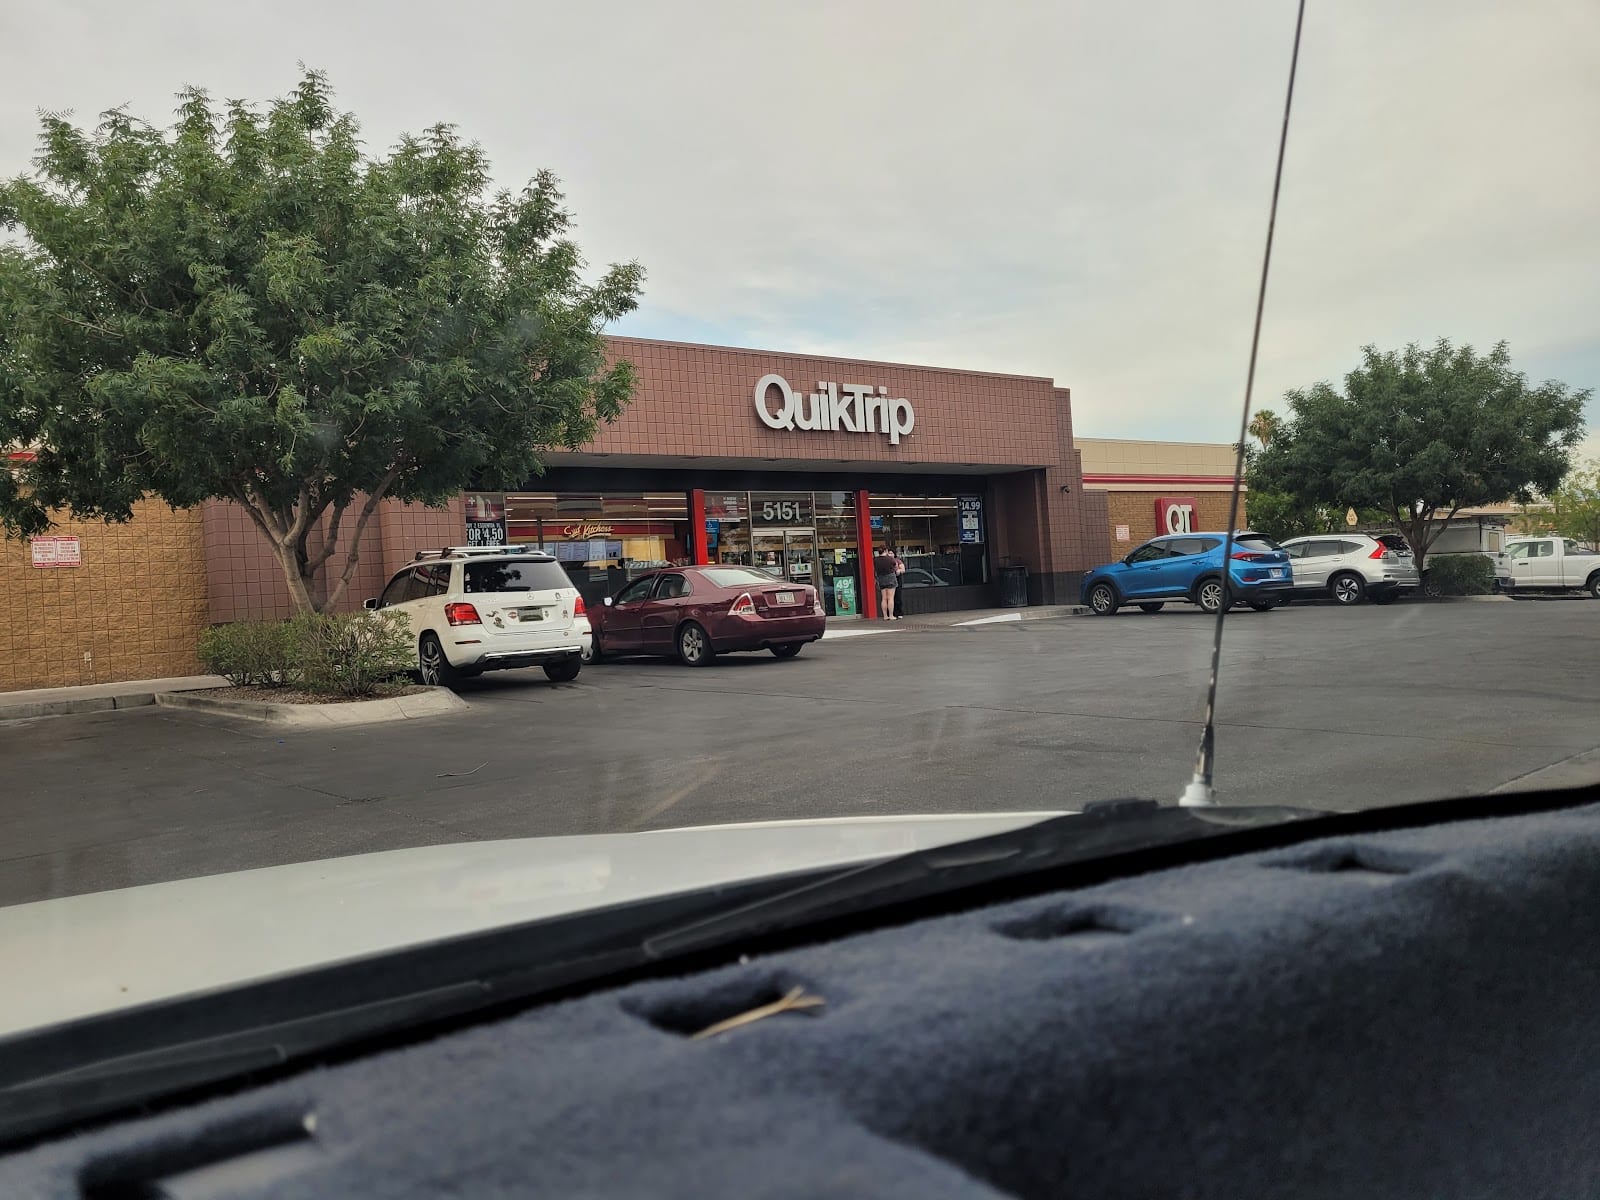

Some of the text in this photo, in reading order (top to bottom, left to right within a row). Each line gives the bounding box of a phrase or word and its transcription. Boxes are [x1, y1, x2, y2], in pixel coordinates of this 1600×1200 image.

[754, 373, 915, 445] QuikTrip
[763, 501, 800, 521] 5151
[1166, 504, 1192, 536] QT
